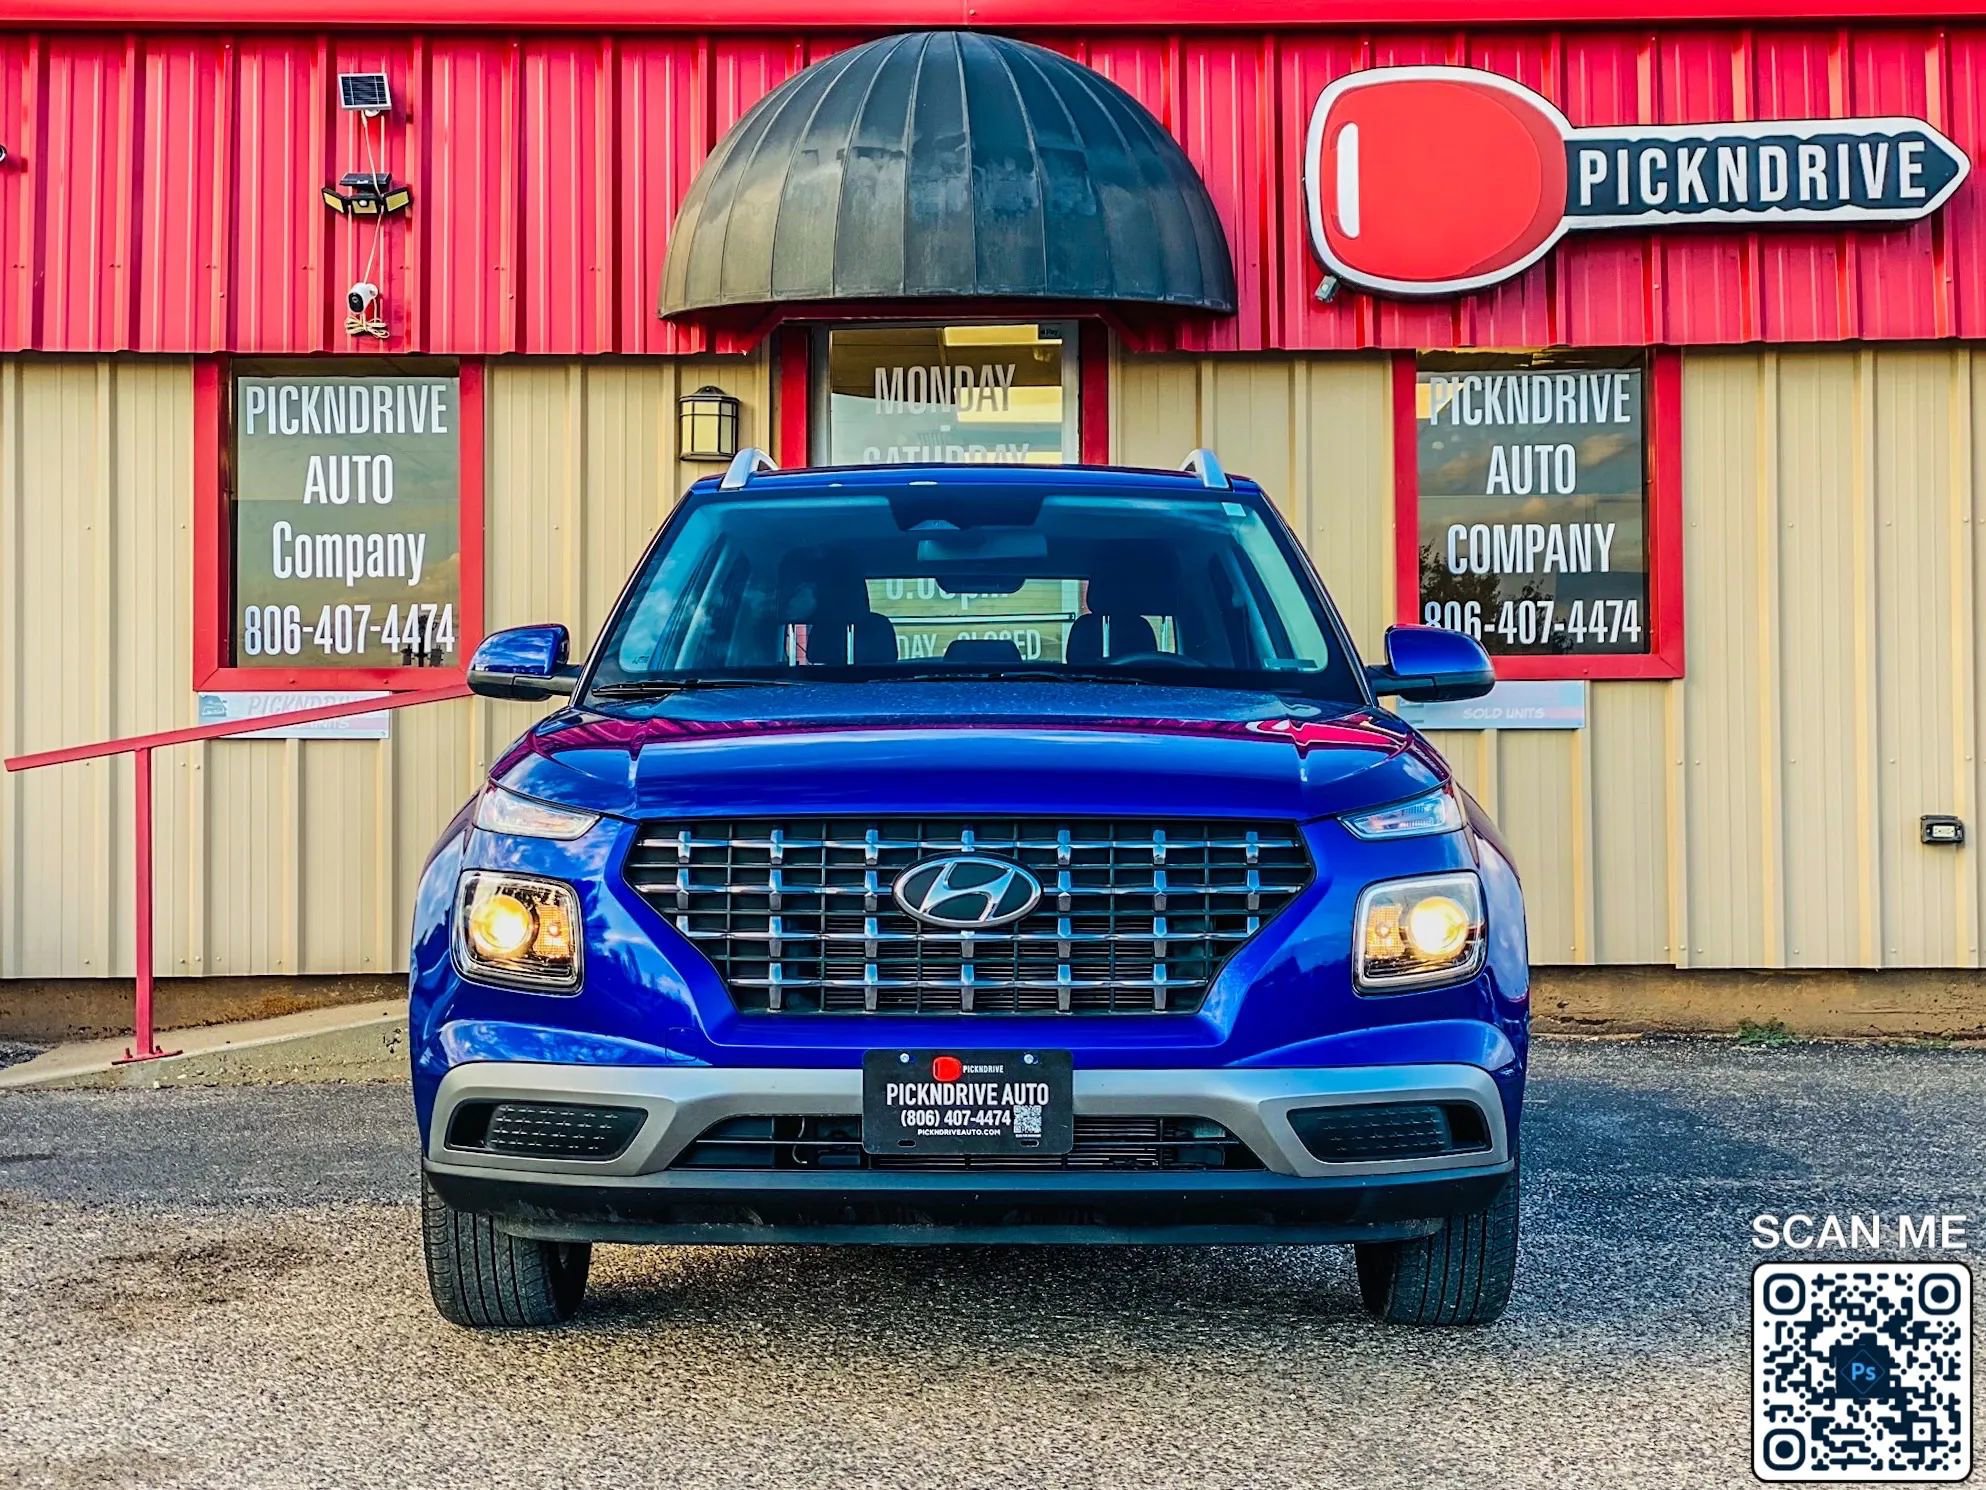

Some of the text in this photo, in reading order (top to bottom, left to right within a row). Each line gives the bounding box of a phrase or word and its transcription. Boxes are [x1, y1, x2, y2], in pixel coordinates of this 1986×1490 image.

[1579, 140, 1926, 206] PICKNDRIVE
[246, 384, 448, 435] PICKNDRIVE
[874, 363, 1016, 415] MONDAY
[1430, 373, 1631, 426] PICKNDRIVE
[302, 454, 394, 505] AUTO
[1486, 443, 1577, 495] AUTO
[272, 520, 426, 587] Company
[1447, 522, 1616, 575] COMPANY
[244, 603, 455, 656] 806-407-4474
[1464, 707, 1545, 720] SOLD UNITS
[886, 1082, 1049, 1106] PICKNDRIVE AUTO
[962, 1064, 1004, 1074] PICKNDRIVE
[901, 1109, 1012, 1127] (806) 407-4474
[917, 1128, 1001, 1136] PICKNDRIVEAUTO.COM
